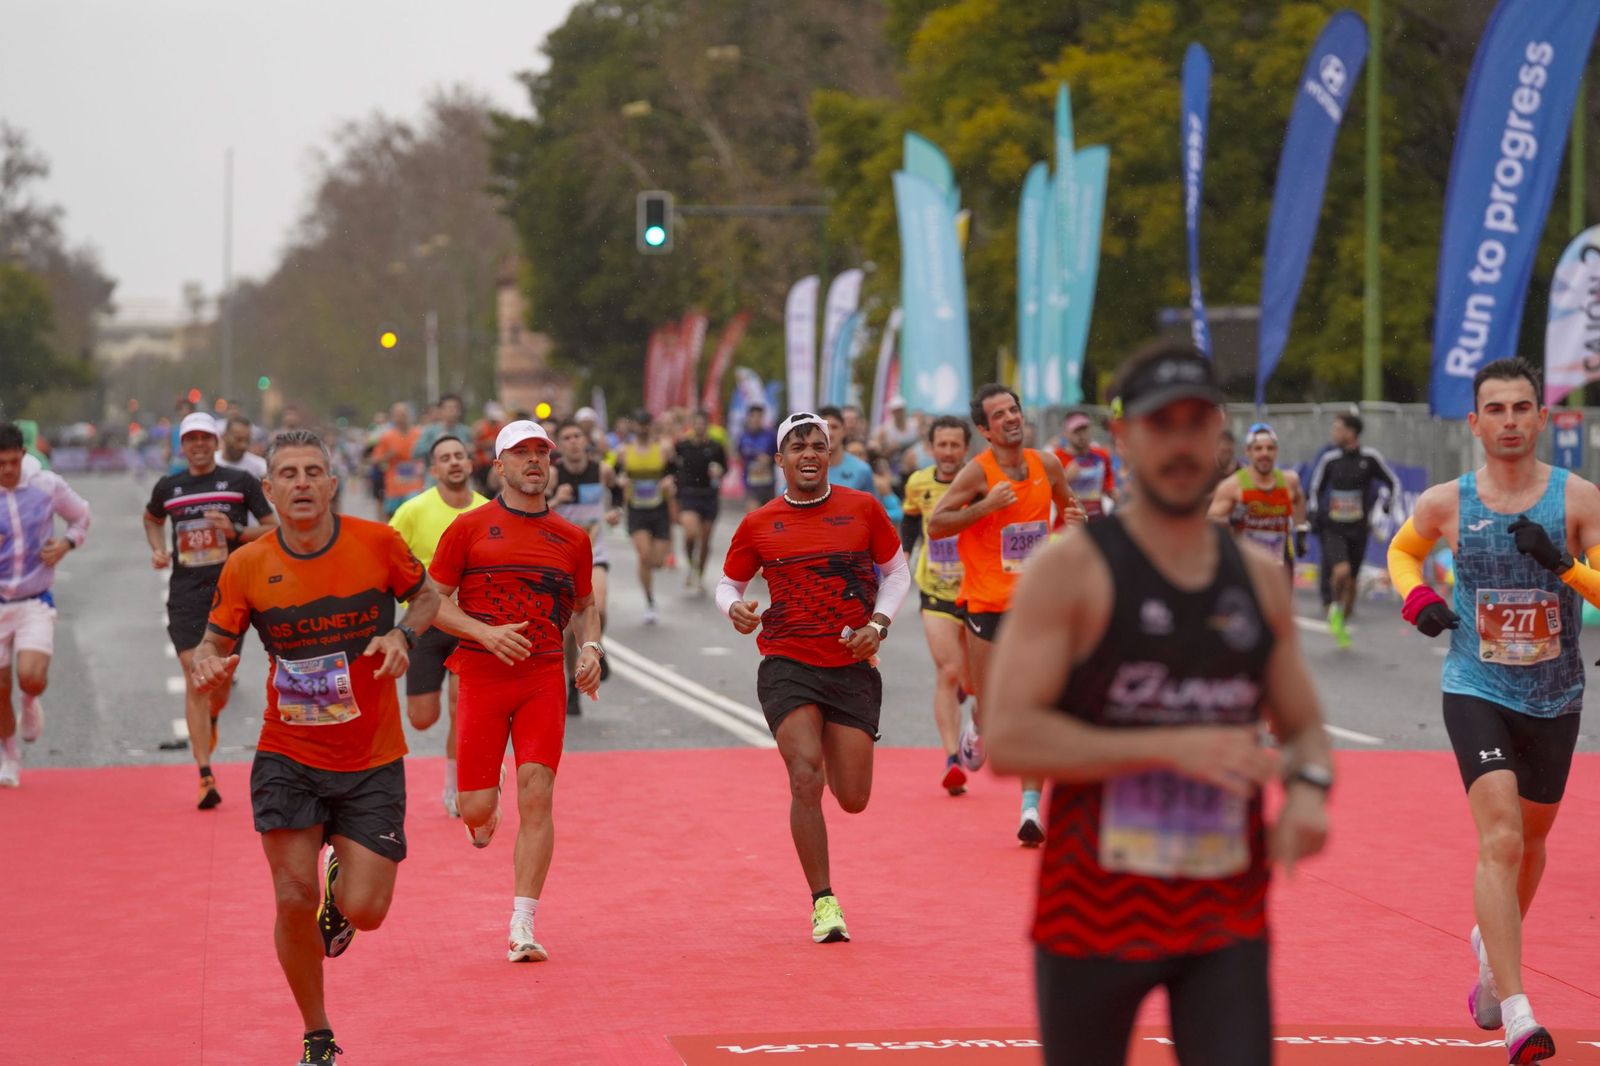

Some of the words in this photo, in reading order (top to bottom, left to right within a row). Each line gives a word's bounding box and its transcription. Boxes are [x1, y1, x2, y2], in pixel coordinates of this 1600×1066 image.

[1484, 41, 1554, 234] progress
[1468, 239, 1507, 285] to
[1445, 295, 1496, 379] Run
[296, 604, 380, 634] CUNETAS
[1501, 608, 1537, 632] 277
